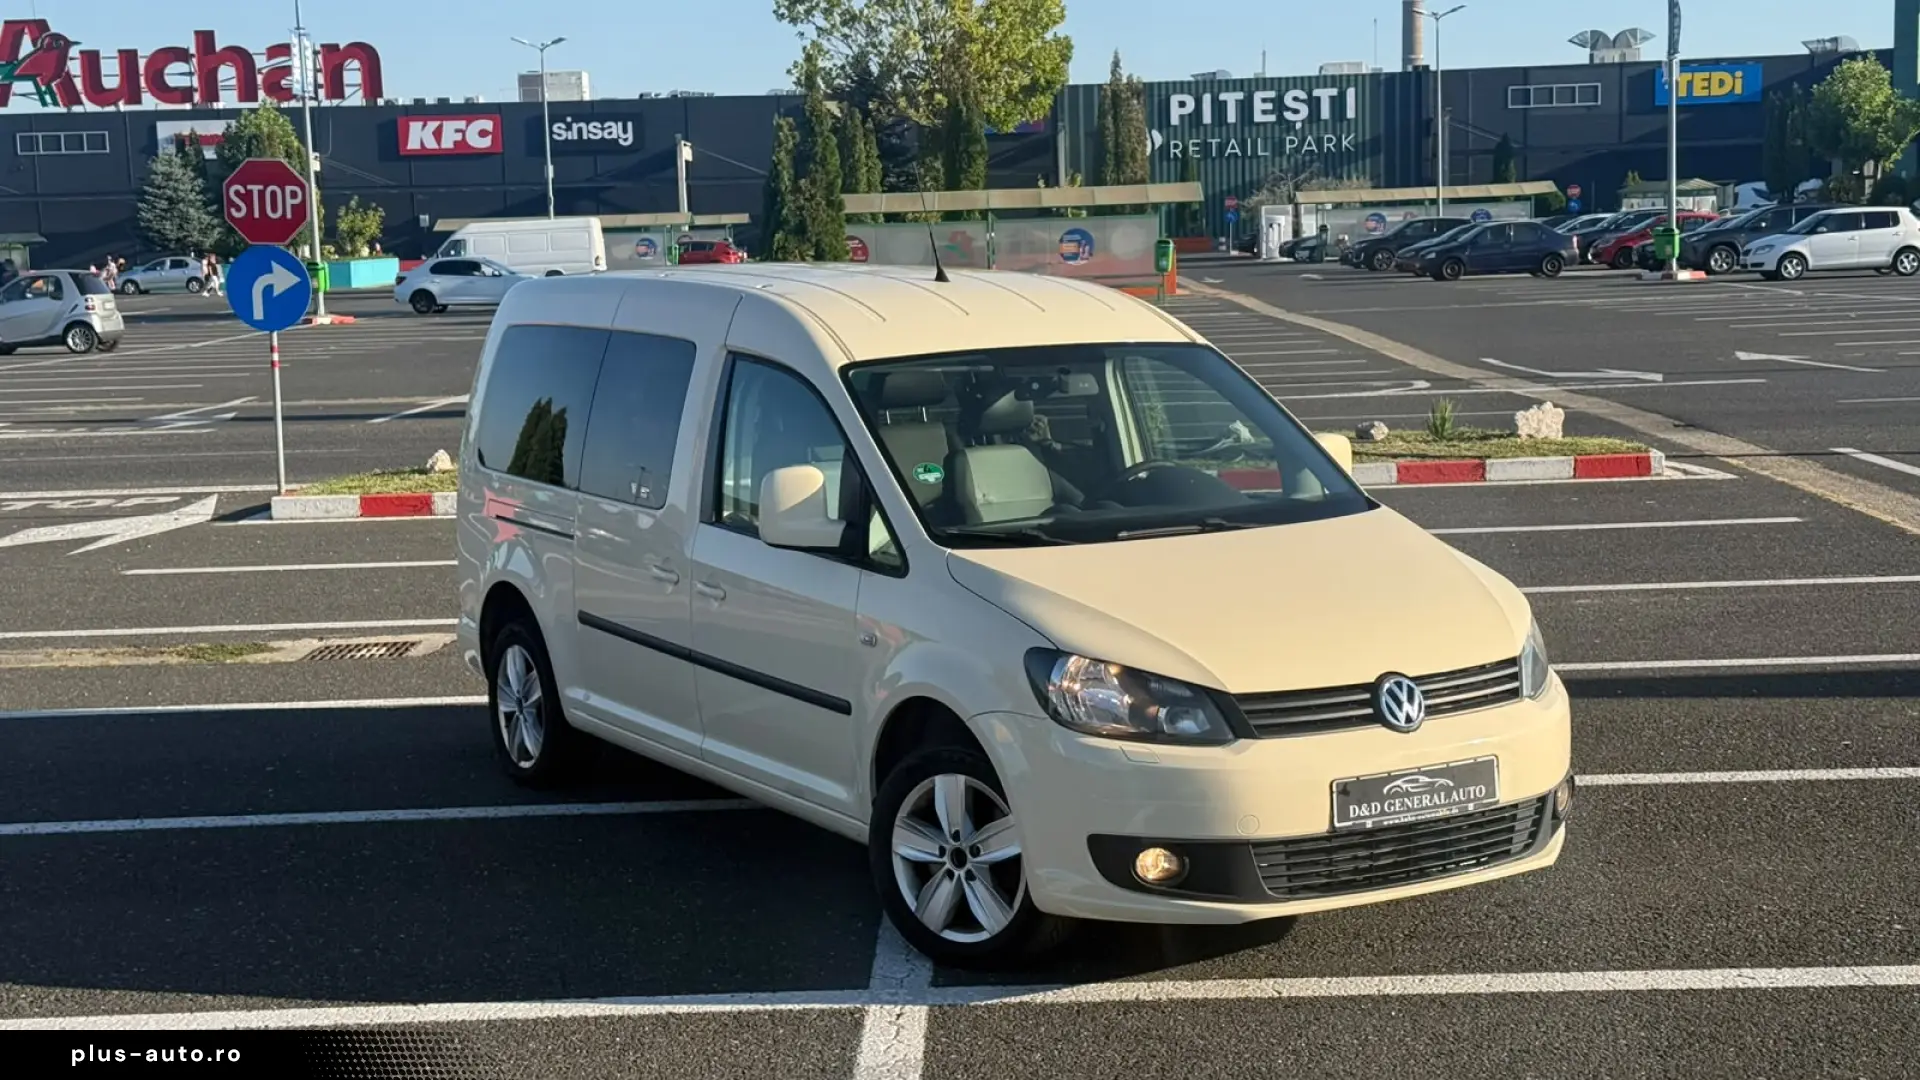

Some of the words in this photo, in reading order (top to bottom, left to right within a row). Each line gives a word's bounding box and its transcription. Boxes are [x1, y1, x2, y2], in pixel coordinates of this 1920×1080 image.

[407, 119, 494, 149] KFC
[552, 116, 634, 146] sinsay
[1170, 137, 1270, 159] RETAIL
[1285, 133, 1356, 154] PARK
[228, 184, 303, 219] STOP
[1349, 802, 1381, 818] D&D
[1384, 792, 1449, 813] GENERAL
[1450, 784, 1486, 803] AUTO
